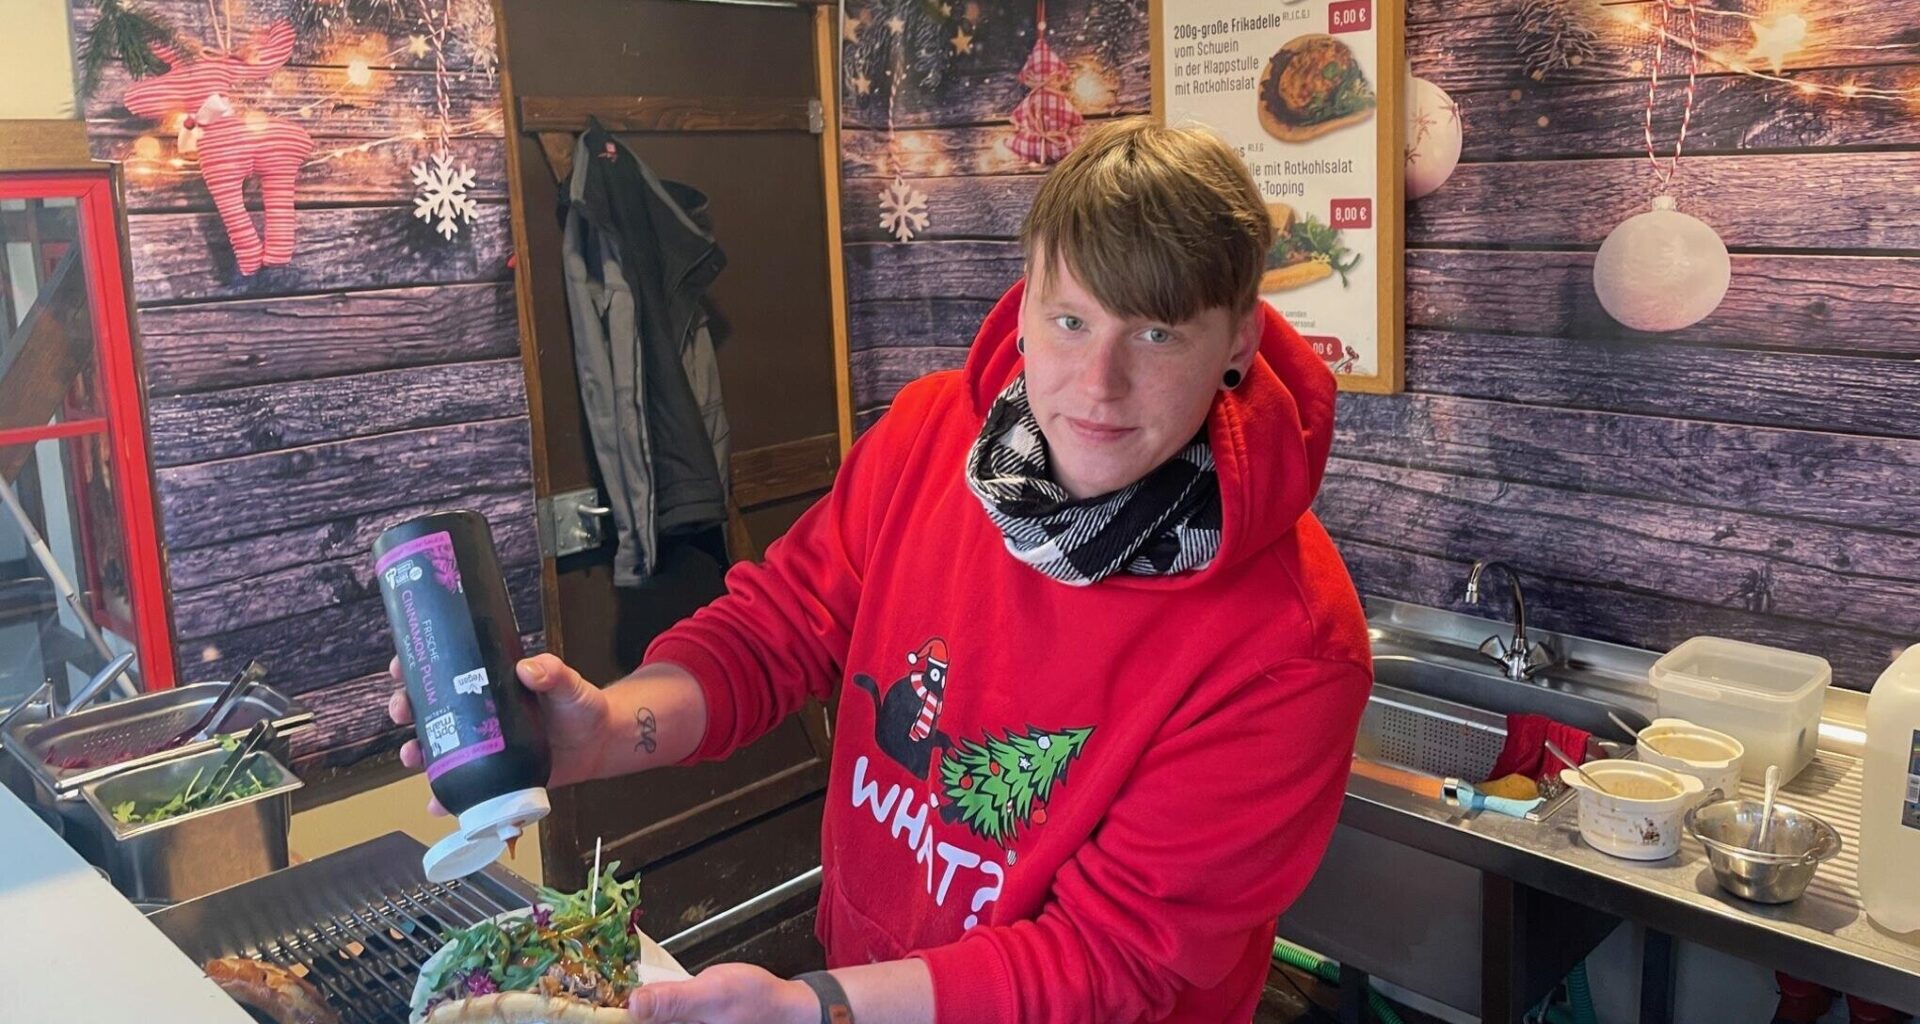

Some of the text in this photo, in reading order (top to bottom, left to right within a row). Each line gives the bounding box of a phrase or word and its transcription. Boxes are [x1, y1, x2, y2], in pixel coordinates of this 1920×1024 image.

[1174, 19, 1229, 40] 200g-große
[1231, 13, 1281, 33] Frikadelle
[1333, 8, 1367, 27] 6,00 €
[1174, 40, 1239, 58] vom Schwein
[1174, 56, 1259, 77] in der Klappstulle
[1175, 76, 1255, 96] mit Rotkohlsalat
[1264, 163, 1281, 176] mit
[1284, 158, 1352, 175] Rotkohlsalat
[1258, 180, 1304, 197] -Topping
[1335, 206, 1367, 223] 8,00 €
[1313, 342, 1334, 356] 00 €
[401, 589, 427, 662] CINNAMON
[420, 664, 437, 705] PLUM
[422, 618, 440, 663] FRISCHE
[402, 634, 416, 670] SAUCE
[457, 672, 485, 686] Vegan
[851, 756, 1004, 930] WHAT?
